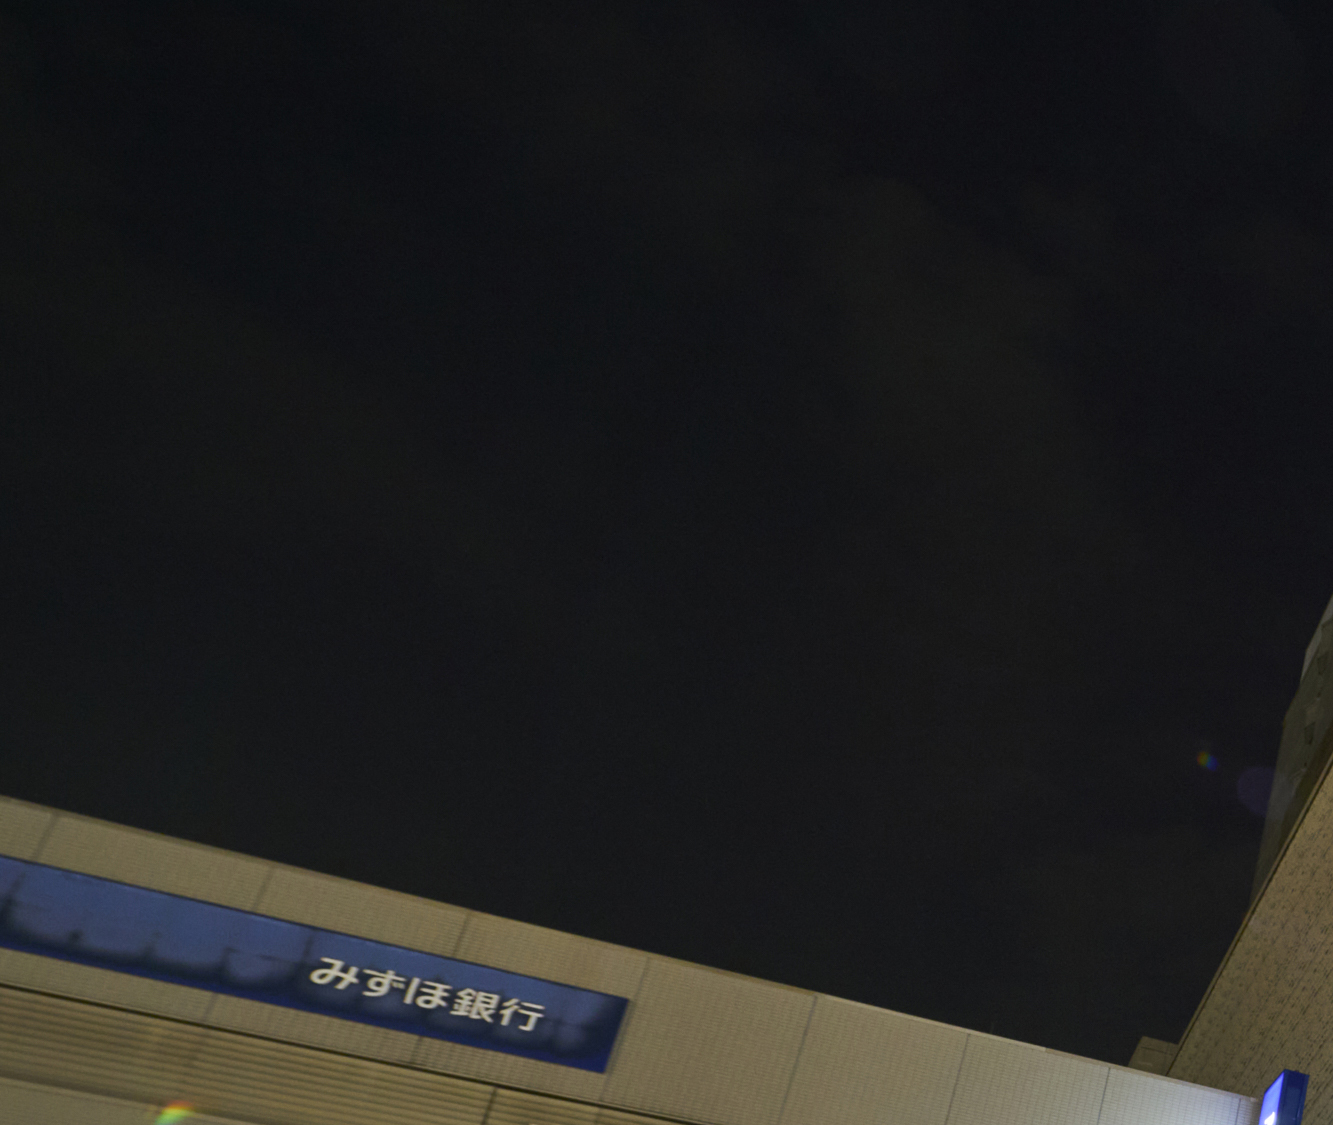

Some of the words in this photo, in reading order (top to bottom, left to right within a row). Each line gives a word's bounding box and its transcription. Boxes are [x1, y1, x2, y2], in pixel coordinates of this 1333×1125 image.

[310, 956, 546, 1032] みずほ銀行
